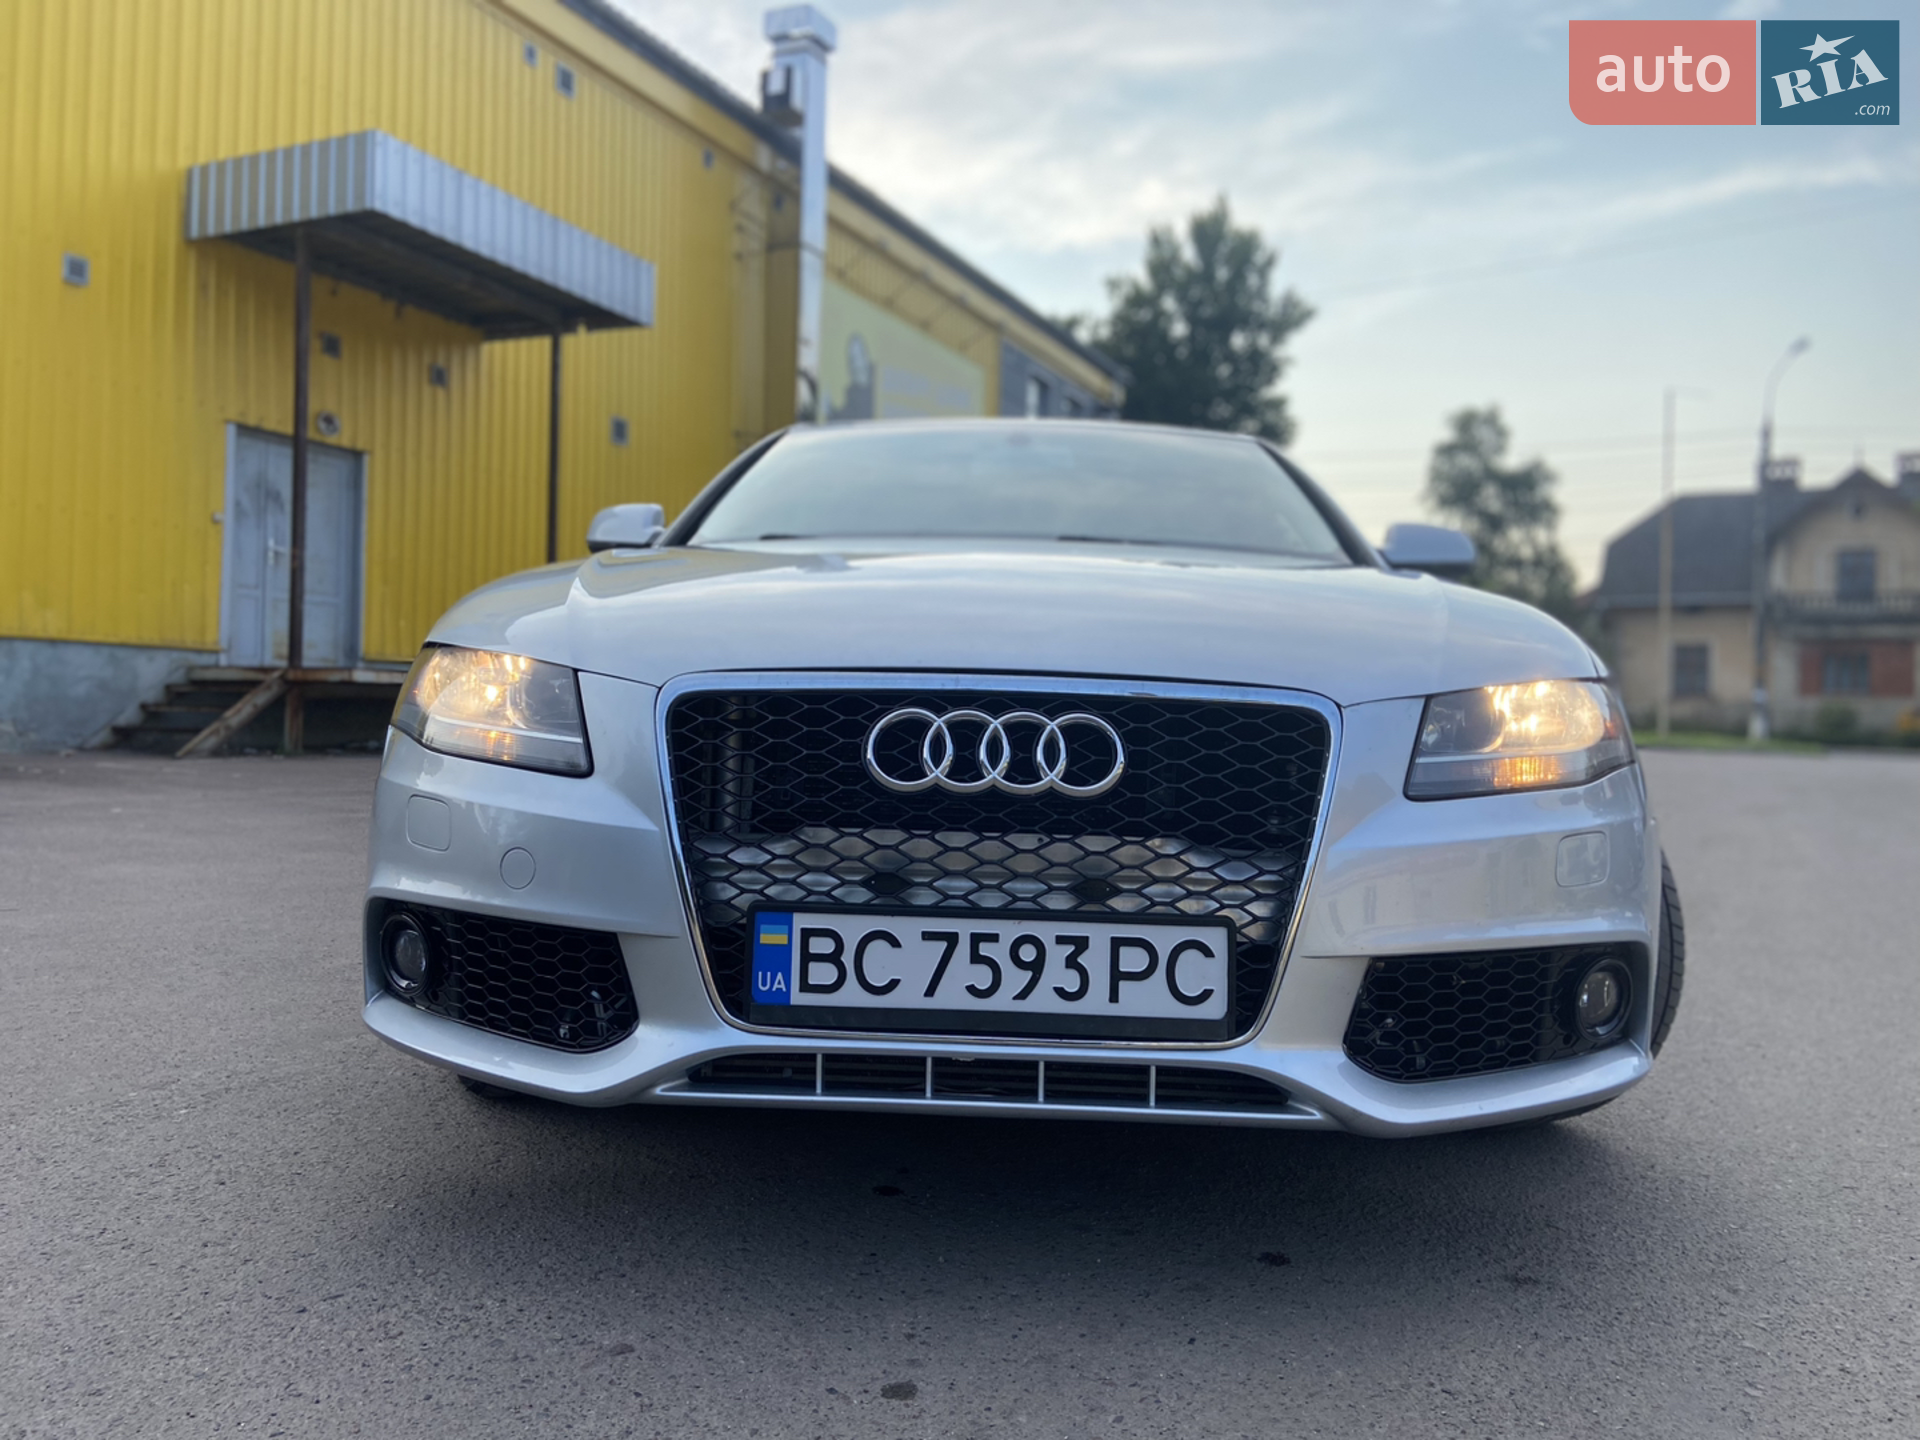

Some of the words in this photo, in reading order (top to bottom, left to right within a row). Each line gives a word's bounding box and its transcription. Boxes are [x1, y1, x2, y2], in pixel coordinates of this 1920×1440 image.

[757, 971, 787, 993] UA
[798, 927, 903, 997] BC
[920, 930, 1090, 1003] 7593
[1108, 935, 1216, 1007] PC
